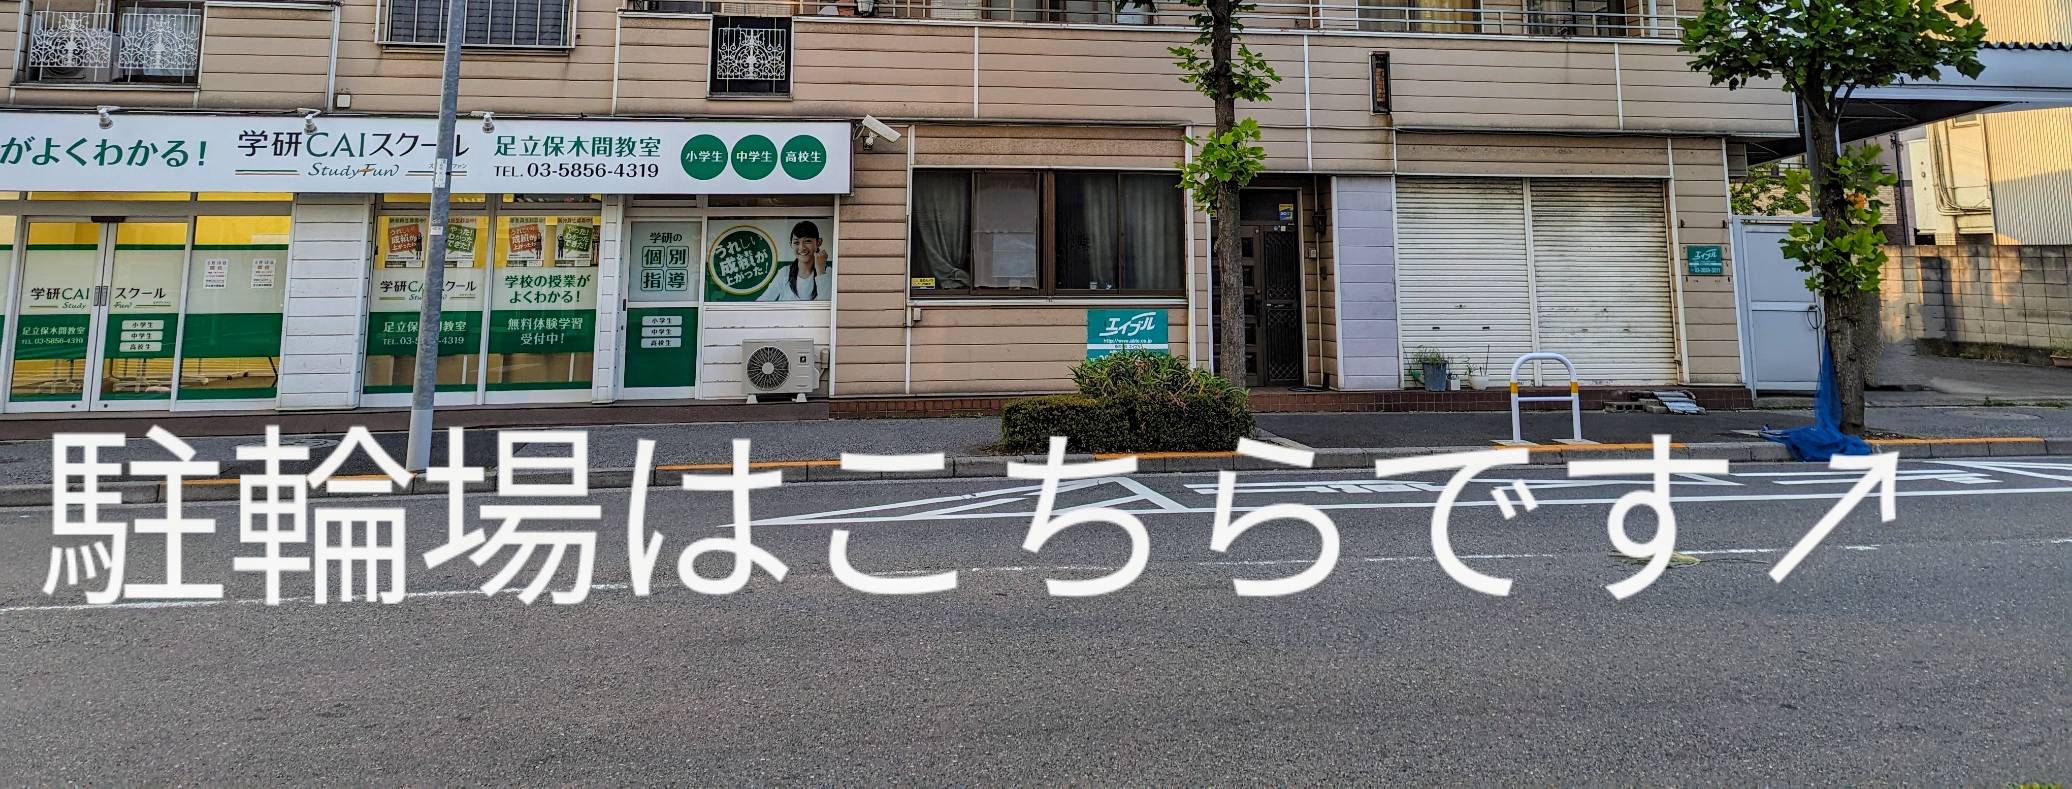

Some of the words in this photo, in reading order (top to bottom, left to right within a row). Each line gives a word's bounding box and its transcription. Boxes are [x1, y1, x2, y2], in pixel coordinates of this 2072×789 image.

[237, 130, 470, 158] 学研CAIスクール
[494, 135, 661, 158] 足立保木間教室
[685, 150, 723, 163] 小学生
[736, 150, 773, 163] 中学生
[785, 150, 822, 163] 高校生
[308, 162, 360, 179] Study
[360, 163, 400, 177] Fun
[526, 162, 660, 179] 03-5856-4319
[649, 232, 683, 244] 学研の
[716, 236, 763, 258] うれしい
[644, 248, 687, 266] 個別
[719, 249, 768, 277] 成績が
[504, 274, 591, 289] 学校の授業が
[643, 272, 686, 289] 指導
[30, 287, 90, 300] 学研CAI
[115, 287, 166, 299] スクール
[509, 290, 580, 303] よくわかる！
[132, 321, 154, 329] 小学生
[383, 321, 467, 332] 足立保教室
[507, 317, 584, 331] 無料体験学習
[652, 317, 672, 325] 小学生
[1099, 311, 1156, 337] エイブル
[22, 326, 86, 336] 足立保木間教室
[34, 337, 84, 345] 03-5856-4319
[520, 332, 565, 345] 受付中！
[650, 339, 672, 347] 高校生
